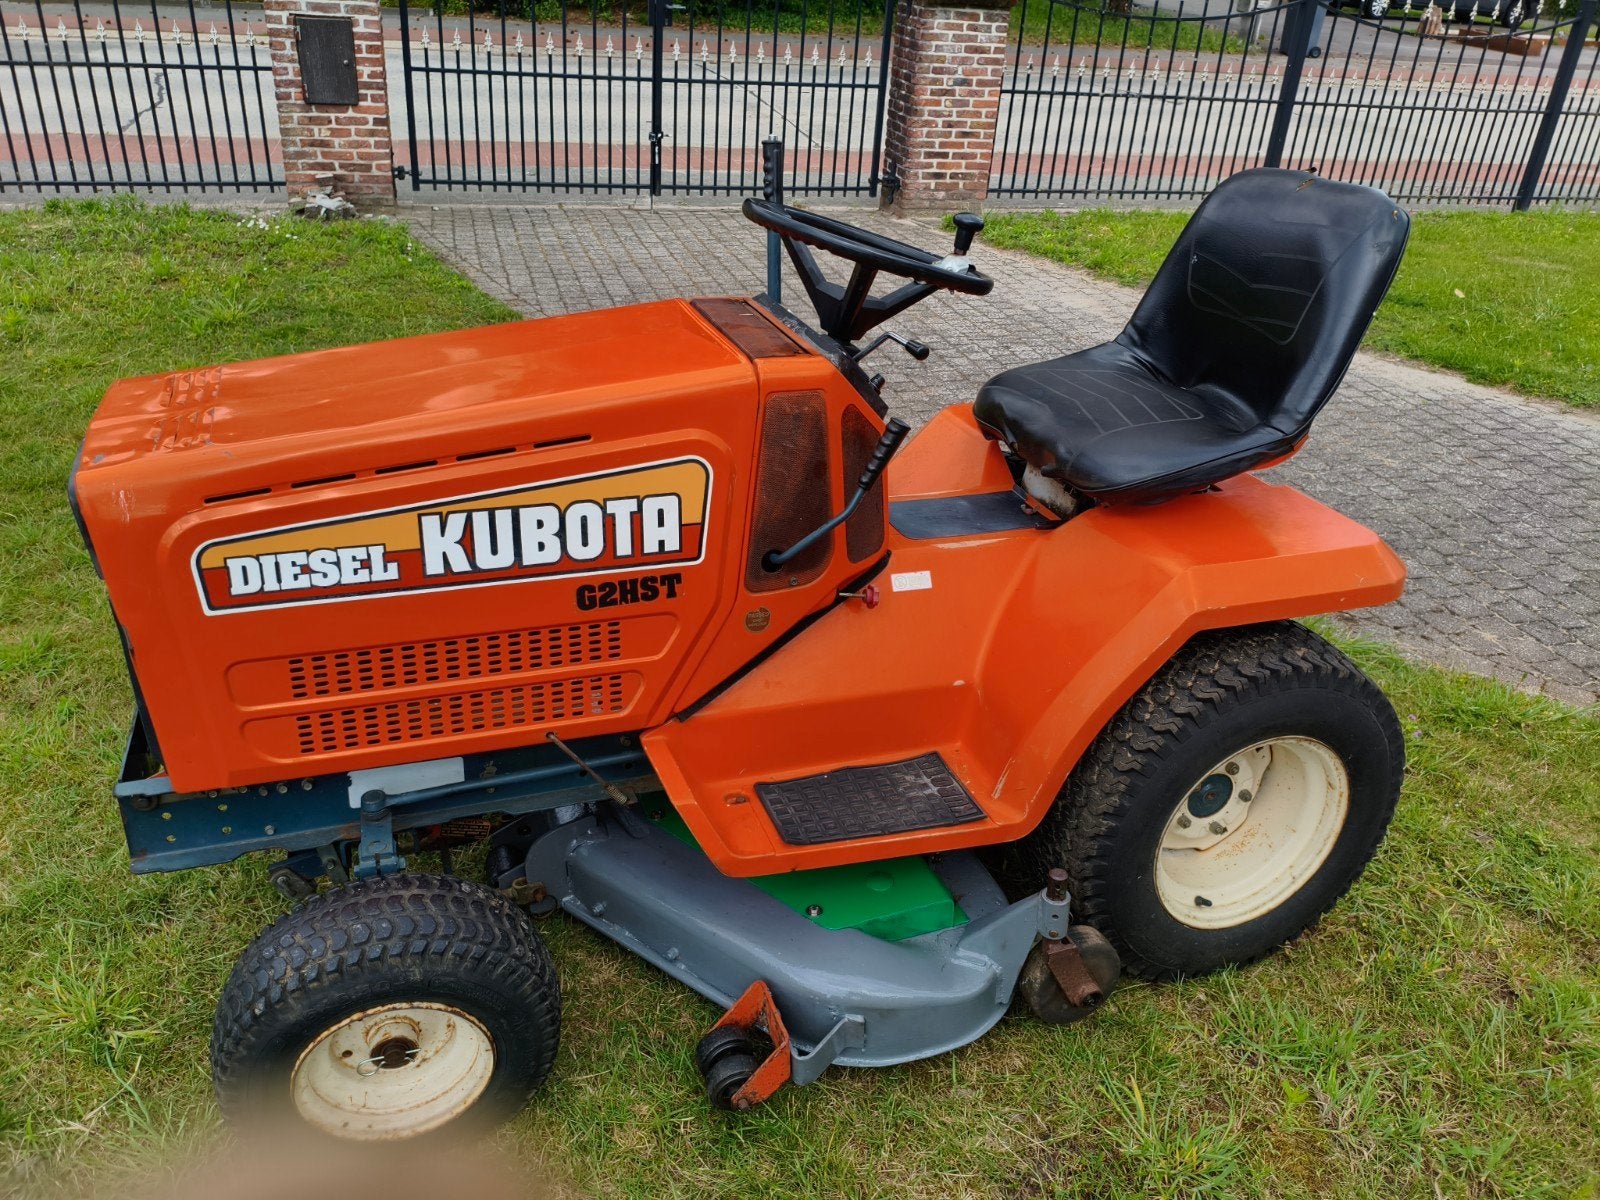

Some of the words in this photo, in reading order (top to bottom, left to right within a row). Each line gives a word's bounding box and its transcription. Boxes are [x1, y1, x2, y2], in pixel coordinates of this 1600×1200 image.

[224, 544, 399, 596] DIESEL
[419, 493, 681, 577] KUBOTA
[576, 573, 682, 611] G2HST
